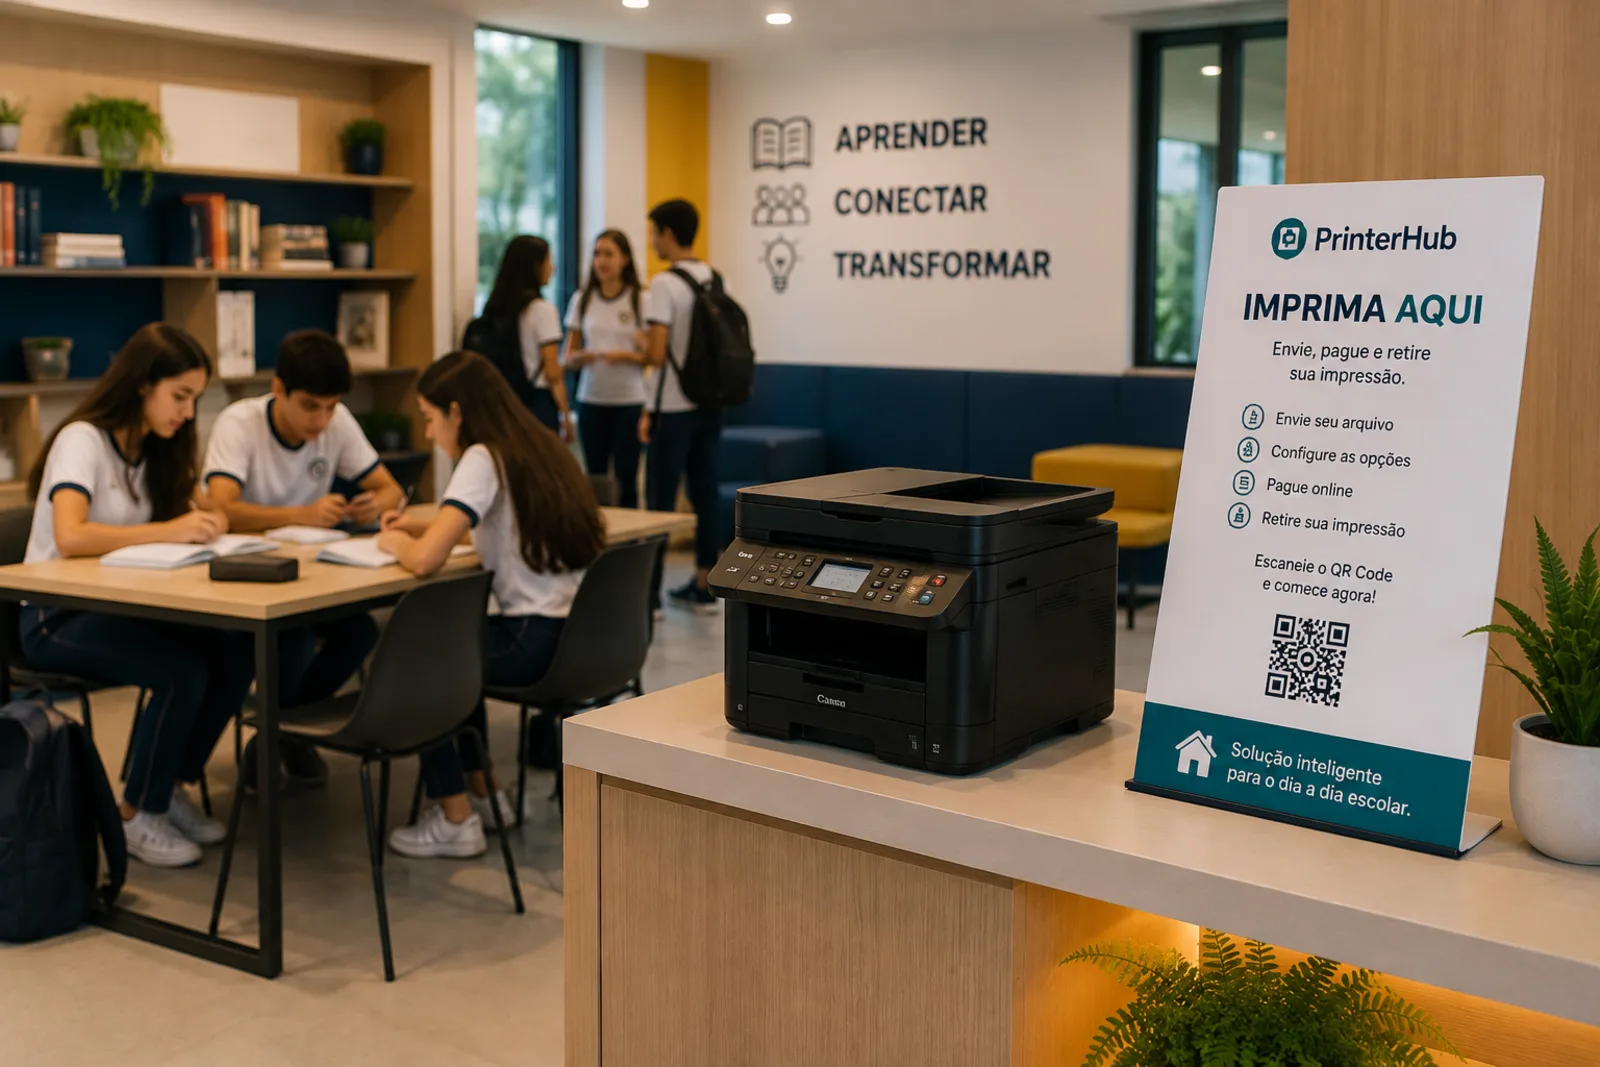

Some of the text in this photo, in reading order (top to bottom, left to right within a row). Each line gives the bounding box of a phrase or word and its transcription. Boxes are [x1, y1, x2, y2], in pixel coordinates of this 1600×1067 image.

[835, 117, 987, 151] APRENDER
[834, 184, 987, 215] CONECTAR
[1315, 225, 1457, 251] PrinterHub
[834, 250, 1051, 278] TRANSFORMAR
[1244, 293, 1483, 327] IMPRIMA AQUI
[1273, 341, 1431, 362] Envie, pague e retire
[1290, 366, 1405, 386] sua impressão.
[1276, 412, 1394, 433] Envie seu arquivo
[1271, 445, 1411, 469] Configure as opções
[1267, 478, 1353, 498] Pague online
[1262, 511, 1405, 538] Retire sua impressão
[1255, 554, 1393, 582] Escaneie o QR Code
[1263, 580, 1376, 604] e comece agora!
[1231, 742, 1382, 785] Solução inteligente
[1227, 768, 1410, 816] para o dia a dia escolar.
